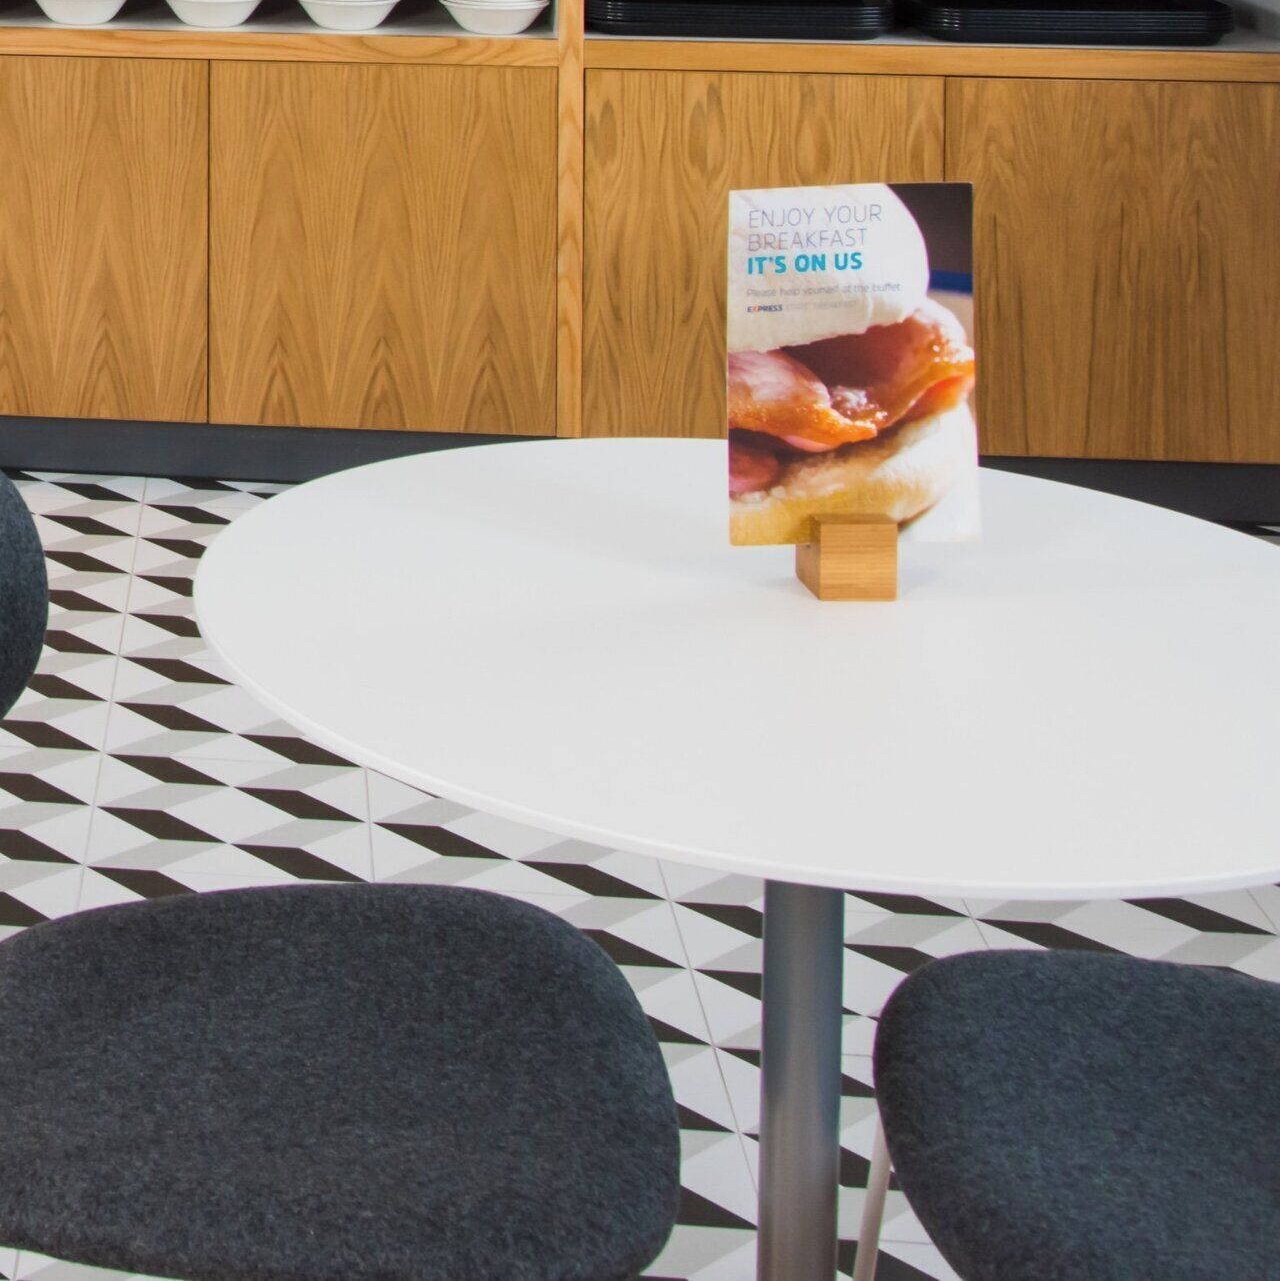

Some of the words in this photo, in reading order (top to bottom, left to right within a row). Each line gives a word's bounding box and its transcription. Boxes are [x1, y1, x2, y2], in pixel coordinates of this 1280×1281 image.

[747, 207, 816, 229] ENJOY
[822, 203, 883, 223] YOUR
[747, 227, 868, 252] BREAKFAST
[747, 254, 788, 275] IT'S
[794, 253, 827, 272] ON
[833, 251, 864, 270] US
[746, 304, 783, 313] EXPRESS
